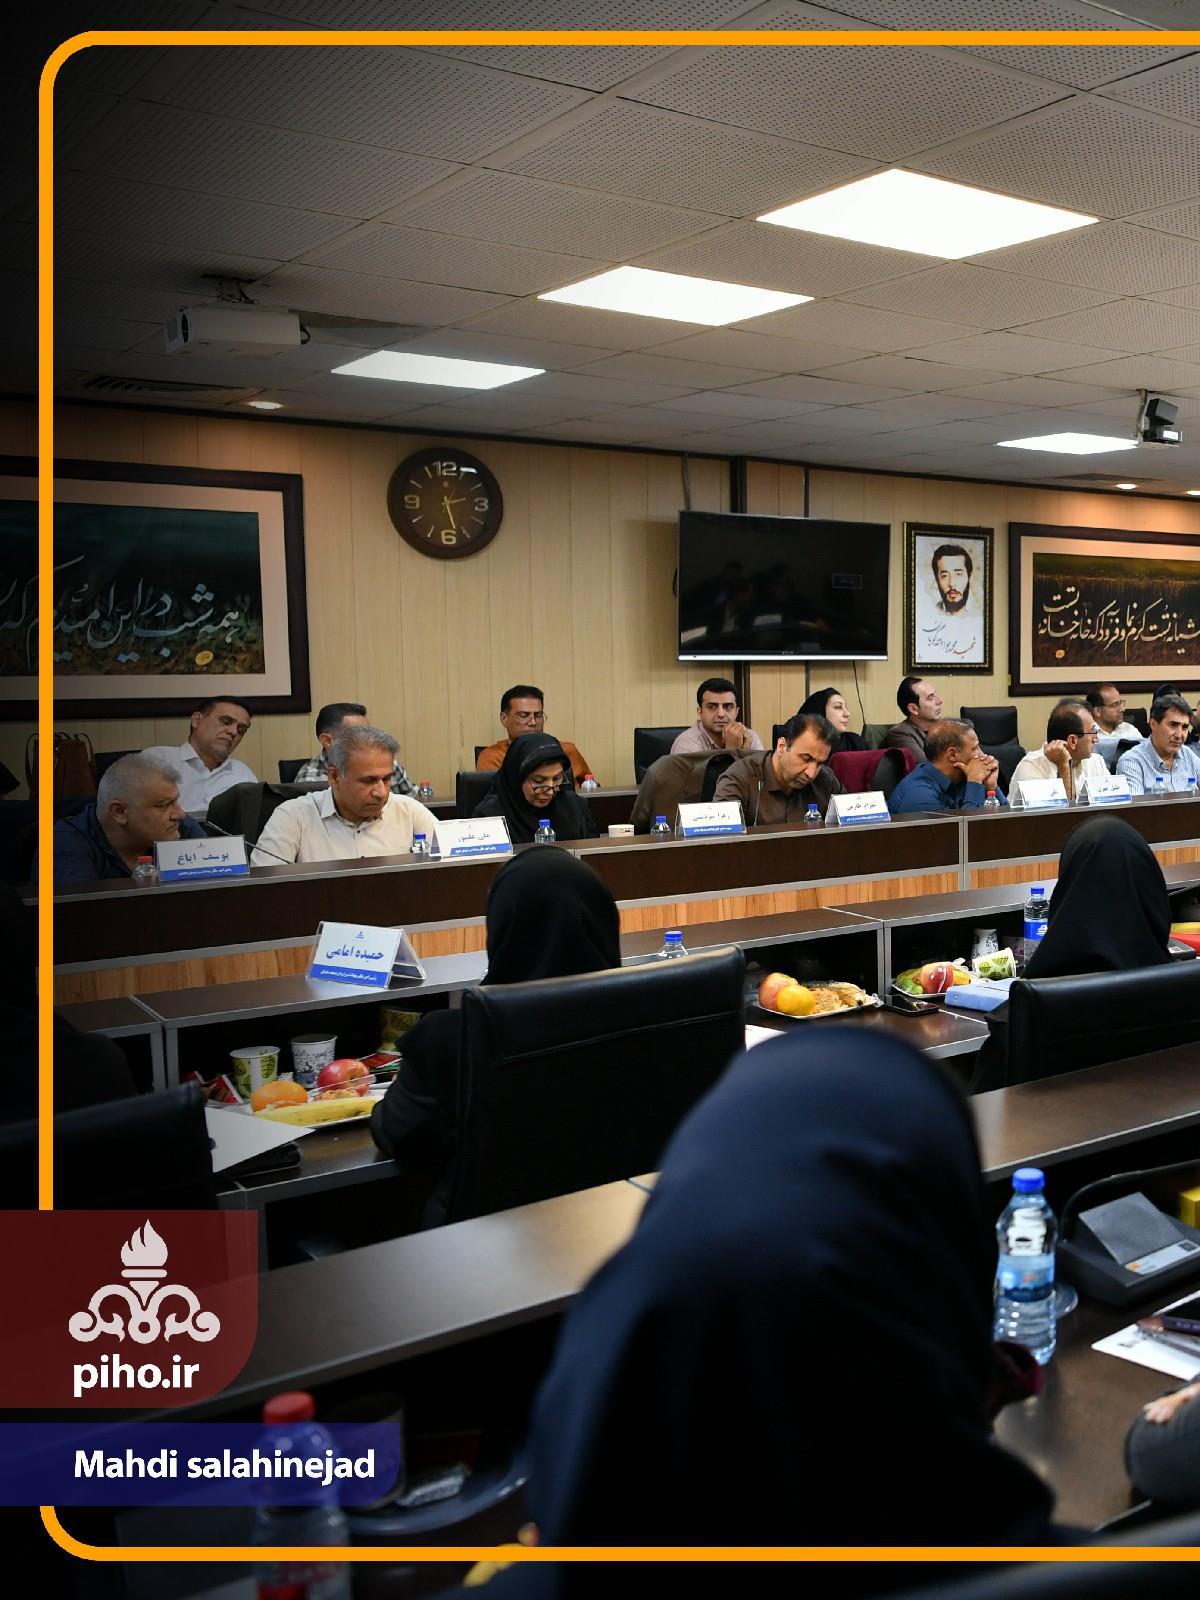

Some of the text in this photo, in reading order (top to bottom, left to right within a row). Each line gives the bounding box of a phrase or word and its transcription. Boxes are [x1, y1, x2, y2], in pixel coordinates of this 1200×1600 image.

[433, 461, 457, 476] 12
[404, 495, 420, 509] 9
[474, 497, 489, 512] 3
[441, 530, 456, 545] 6
[202, 851, 230, 863] یوسف
[325, 943, 385, 963] حمیده امامی
